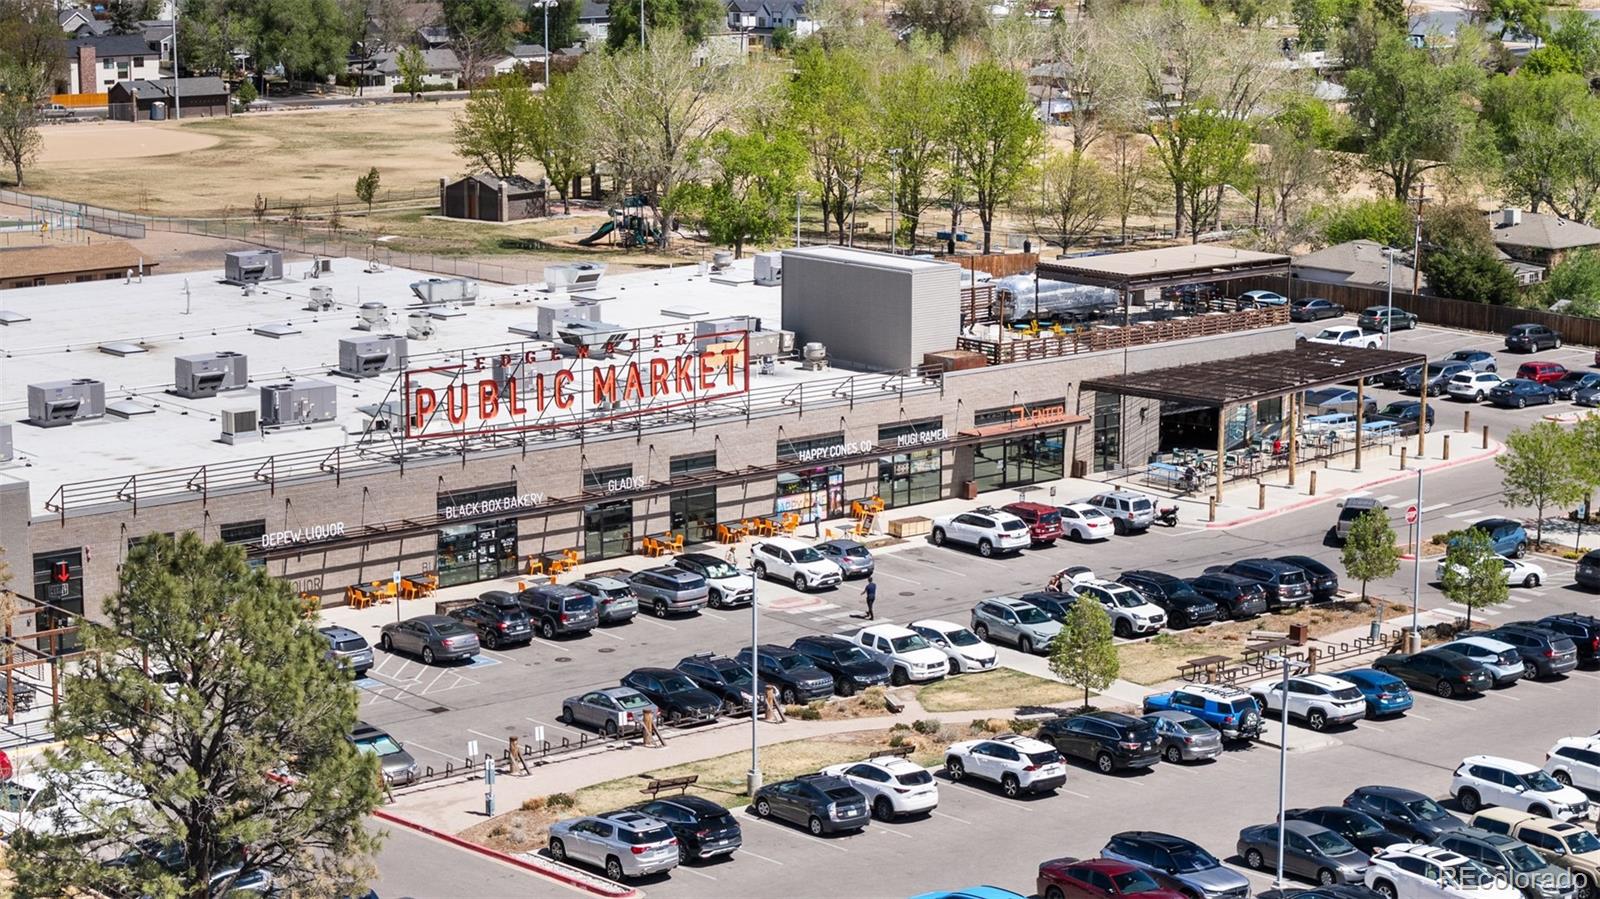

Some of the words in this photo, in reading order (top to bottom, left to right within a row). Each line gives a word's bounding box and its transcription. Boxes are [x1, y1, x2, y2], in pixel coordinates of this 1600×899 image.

[474, 332, 688, 370] EDGEWATER
[415, 369, 575, 428] PUBLIC
[593, 349, 740, 405] MARKET
[1031, 405, 1064, 420] ENTER
[897, 432, 918, 447] MUGI
[920, 428, 948, 444] RAMEN
[799, 446, 829, 462] HAPPY
[829, 441, 858, 458] CONES
[859, 440, 872, 453] CO
[607, 475, 645, 492] GLADYS
[445, 502, 480, 519] BLACK
[481, 498, 502, 514] BOX
[503, 492, 544, 510] BAKERY
[261, 529, 302, 547] DEPEW
[305, 521, 345, 541] LIQUOR
